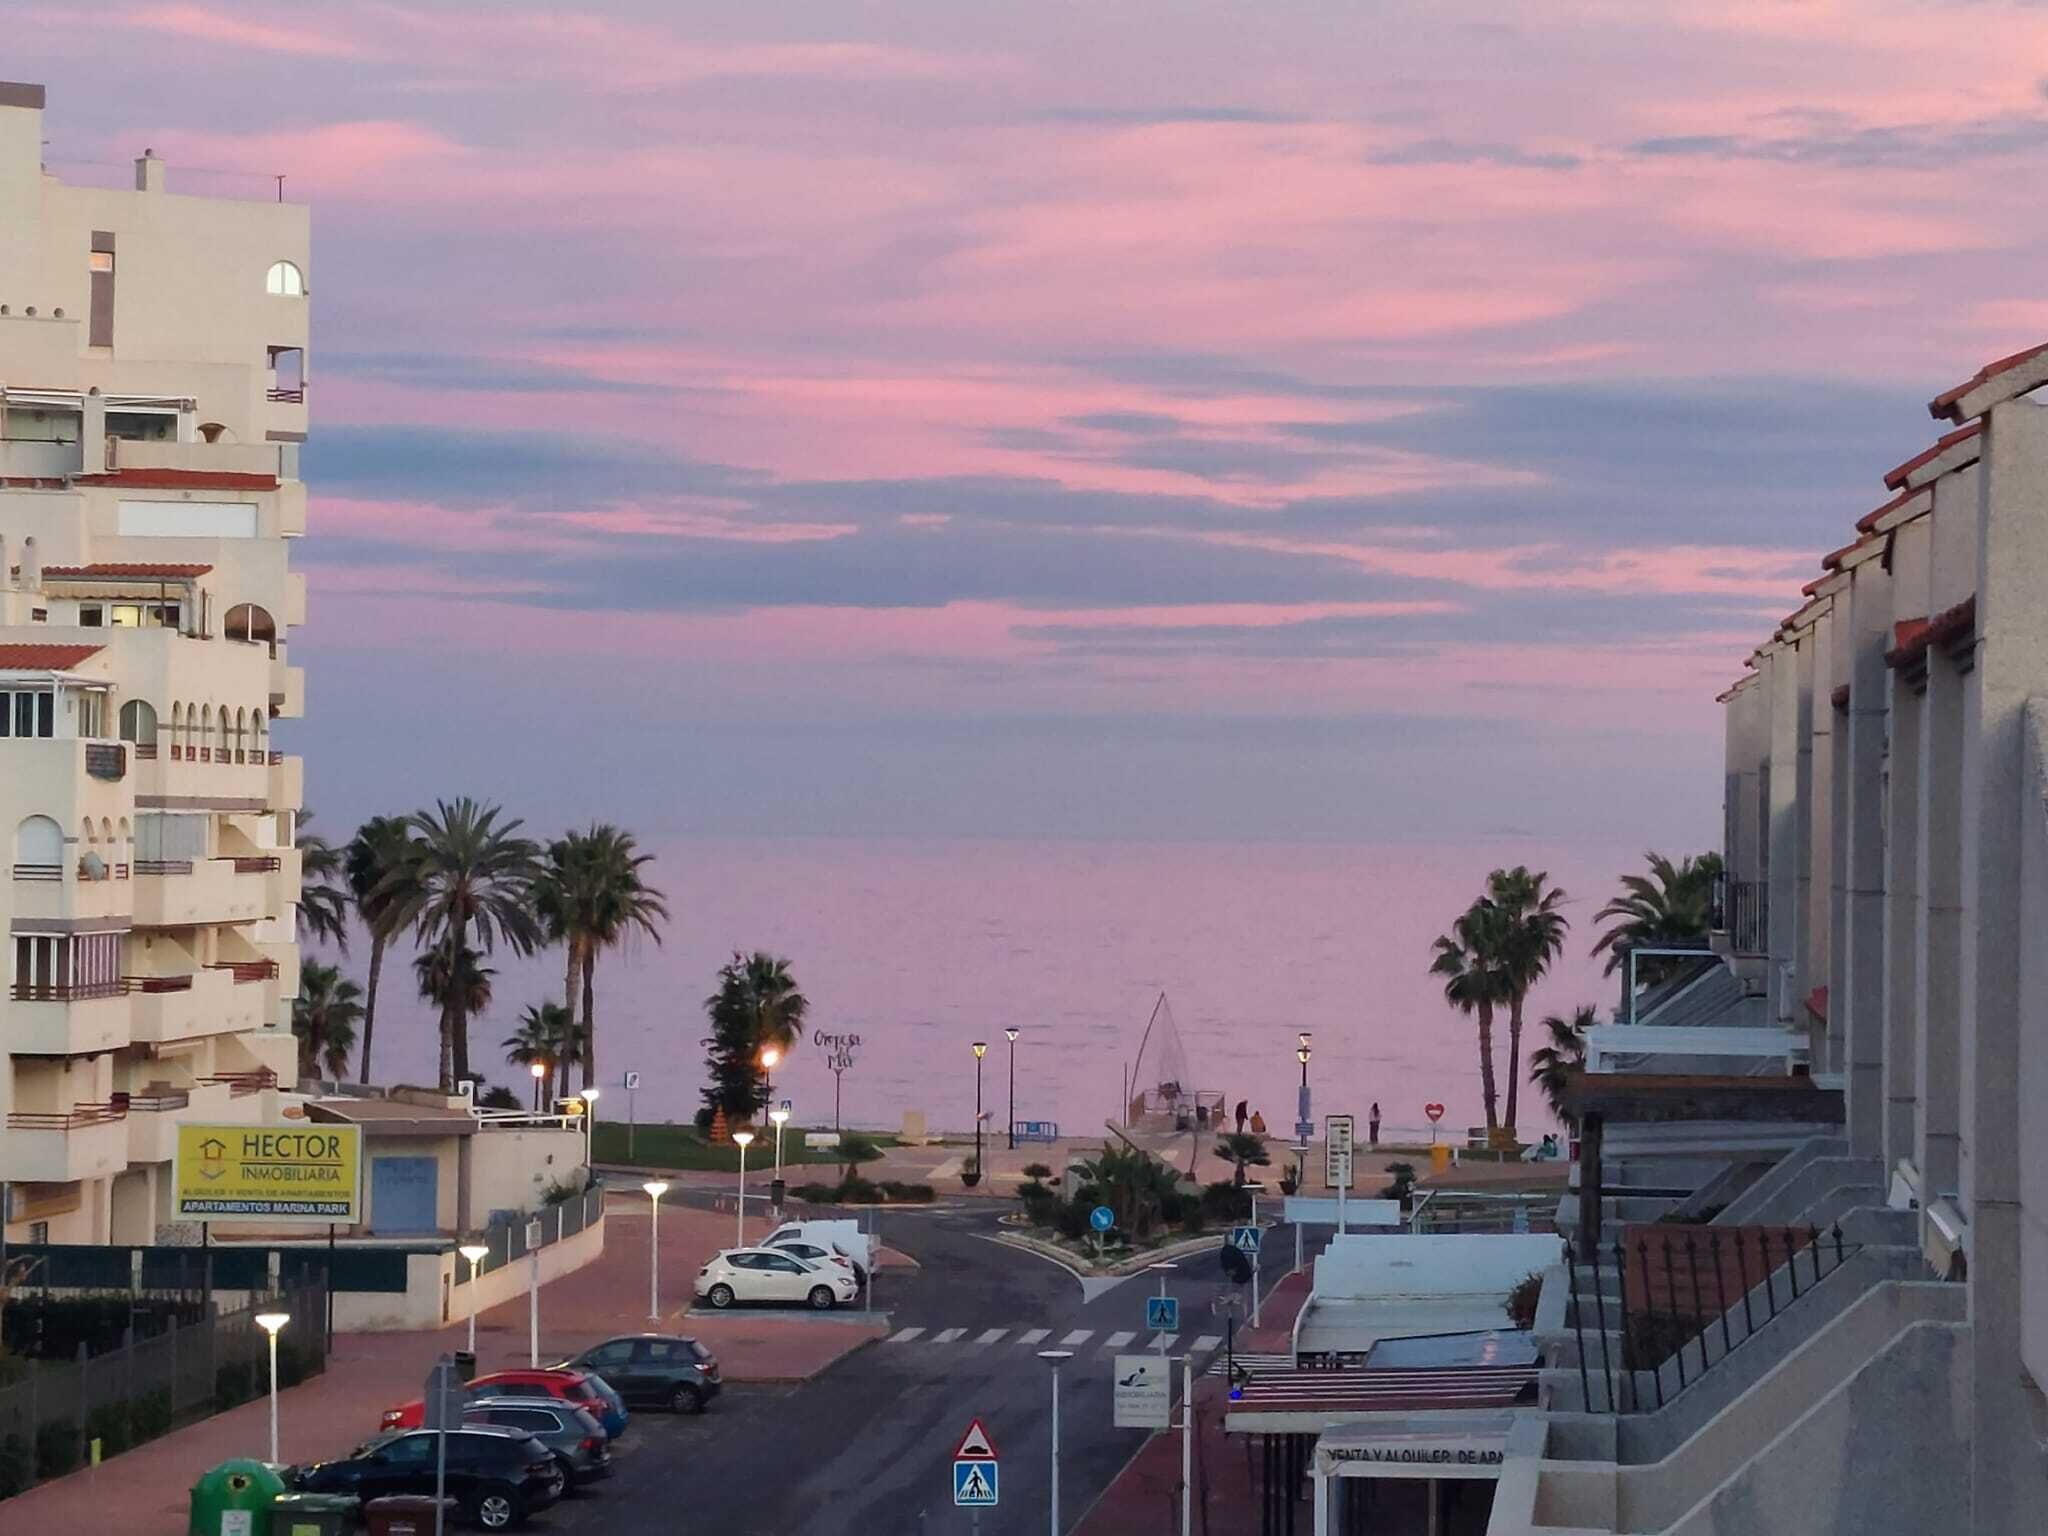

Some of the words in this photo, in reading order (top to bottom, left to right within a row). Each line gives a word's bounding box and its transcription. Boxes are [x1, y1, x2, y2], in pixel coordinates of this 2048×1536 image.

[243, 1134, 341, 1158] HECTOR
[241, 1166, 340, 1181] INMOBILIARIA
[280, 1189, 350, 1198] APARTAMENTOS
[183, 1201, 271, 1212] APARTAMENTOS
[273, 1202, 316, 1213] MARINA
[318, 1203, 348, 1214] PARK
[1328, 1449, 1369, 1461] VENTA
[1370, 1449, 1381, 1461] Y
[1385, 1449, 1450, 1463] ALQUILER
[1458, 1451, 1478, 1464] DE
